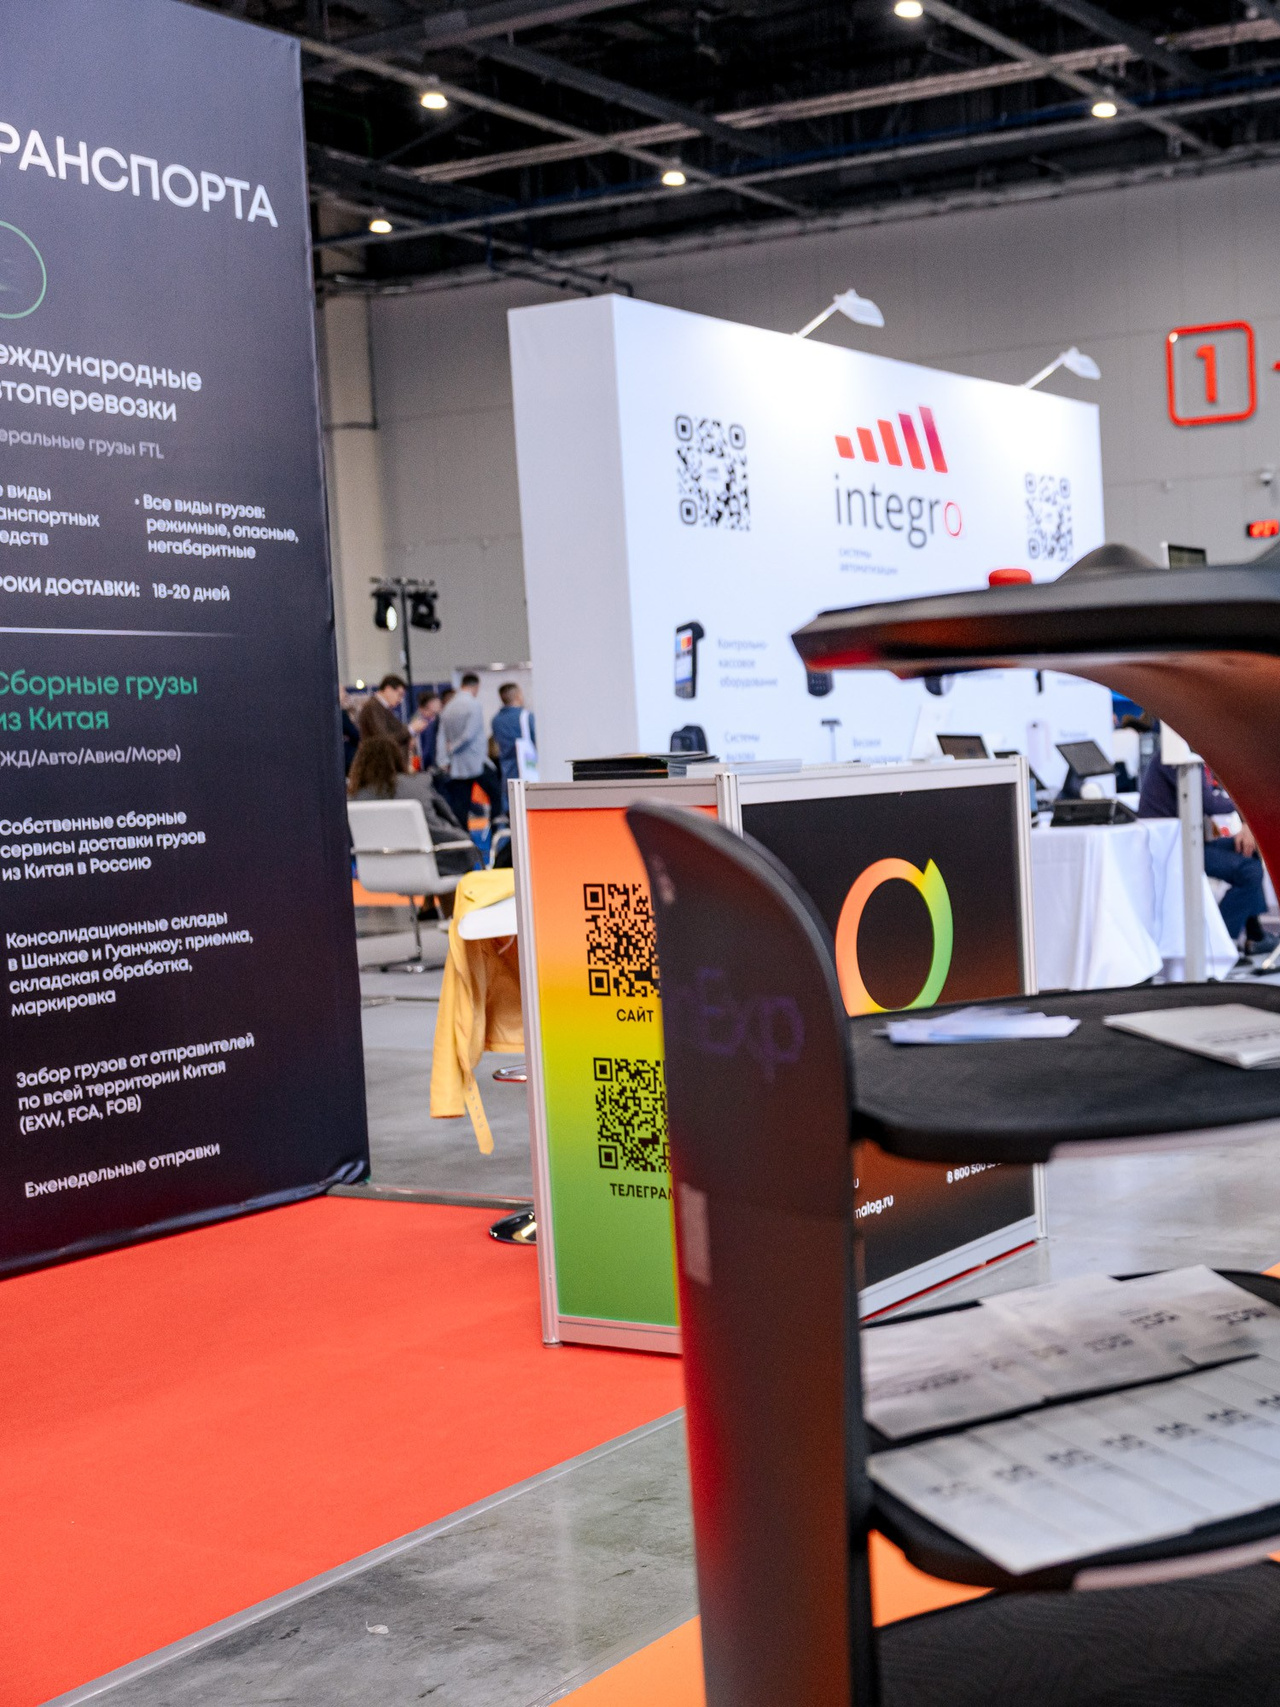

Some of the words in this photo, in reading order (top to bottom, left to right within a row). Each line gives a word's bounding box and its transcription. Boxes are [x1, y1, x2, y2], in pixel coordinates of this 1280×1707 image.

[1196, 345, 1217, 403] 1
[0, 380, 177, 422] топеревозки
[89, 438, 136, 457] грузы
[139, 441, 165, 459] FTL
[143, 493, 172, 511] Все
[174, 499, 213, 516] виды
[215, 502, 266, 520] грузов:
[834, 473, 962, 549] integro
[146, 518, 231, 539] режимные,
[232, 524, 299, 543] опасные,
[148, 539, 256, 559] негабаритные
[45, 577, 140, 598] ДОСТАВКИ:
[152, 583, 190, 599] 18-20
[193, 585, 231, 602] дней
[125, 675, 198, 700] грузы
[29, 706, 110, 731] Китая
[0, 816, 114, 836] Собственные
[116, 810, 187, 830] сборные
[1, 840, 75, 860] сервисы
[78, 834, 153, 855] доставки
[156, 831, 206, 850] грузов
[2, 866, 22, 882] из
[24, 861, 74, 879] Китая
[77, 861, 87, 875] в
[89, 856, 152, 874] Россию
[6, 918, 169, 950] Консолидационные
[171, 911, 228, 930] склады
[8, 957, 18, 972] в
[21, 949, 89, 970] Шанхае
[92, 947, 101, 961] и
[105, 937, 183, 962] Гуанчжоу:
[185, 929, 254, 952] приемка,
[9, 969, 99, 994] складская
[102, 957, 193, 982] обработка,
[11, 989, 116, 1017] маркировка
[616, 1006, 654, 1023] САЙТ
[16, 1066, 71, 1088] Забор
[74, 1057, 128, 1080] грузов
[130, 1053, 148, 1068] от
[150, 1032, 255, 1065] отправителей
[18, 1095, 40, 1111] по
[43, 1084, 83, 1106] всей
[86, 1068, 180, 1098] территории
[183, 1060, 227, 1080] Китая
[19, 1111, 65, 1136] (EXW,
[68, 1103, 103, 1125] FCA,
[106, 1094, 142, 1116] FOB)
[24, 1159, 147, 1198] Еженедельные
[149, 1143, 221, 1170] отправки
[946, 1170, 953, 1184] 8
[954, 1166, 970, 1181] 800
